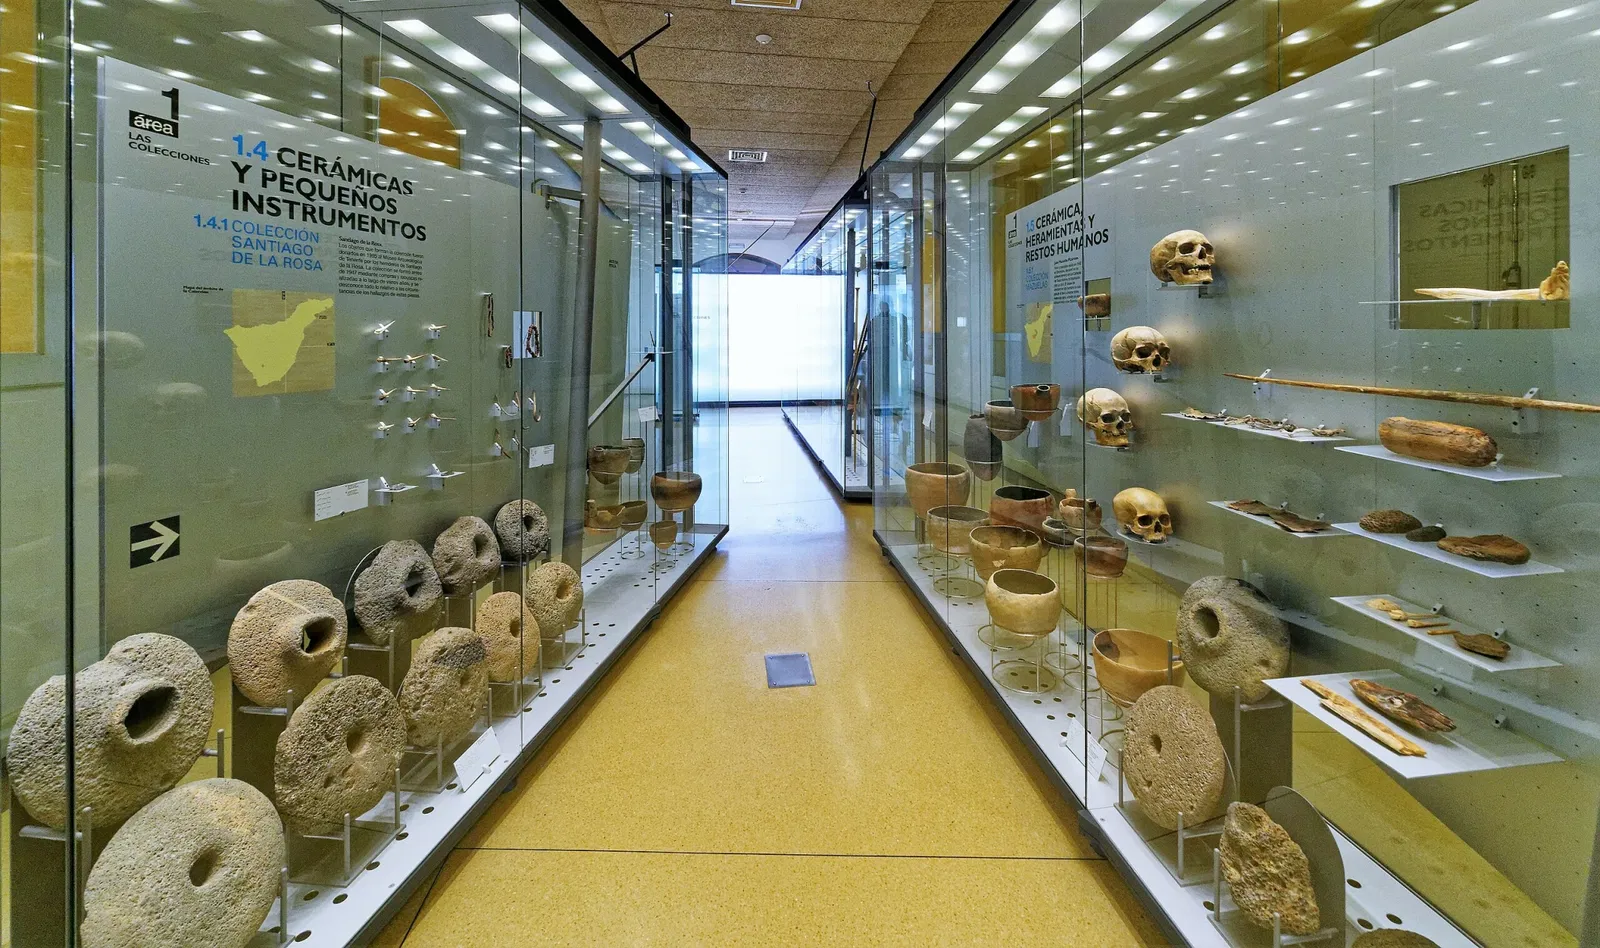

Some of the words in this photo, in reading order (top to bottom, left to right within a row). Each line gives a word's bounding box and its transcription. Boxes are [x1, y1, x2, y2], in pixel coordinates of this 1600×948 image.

[161, 87, 179, 120] 1
[129, 132, 151, 143] LAS
[133, 114, 174, 135] área
[129, 142, 210, 165] COLECCIONES
[232, 134, 269, 161] 1.4
[276, 147, 413, 195] CERÁMICAS
[231, 160, 252, 184] Y
[261, 168, 398, 215] PEQUEÑOS
[193, 213, 228, 231] 1.4.1
[231, 219, 320, 244] COLECCIÓN
[232, 189, 426, 241] INSTRUMENTOS
[1088, 213, 1095, 229] Y
[232, 235, 314, 257] SANTIAGO
[1025, 244, 1055, 263] RESTOS
[1056, 228, 1109, 255] HUMANOS
[232, 251, 253, 265] DE
[259, 254, 278, 267] LA
[283, 256, 323, 271] ROSA
